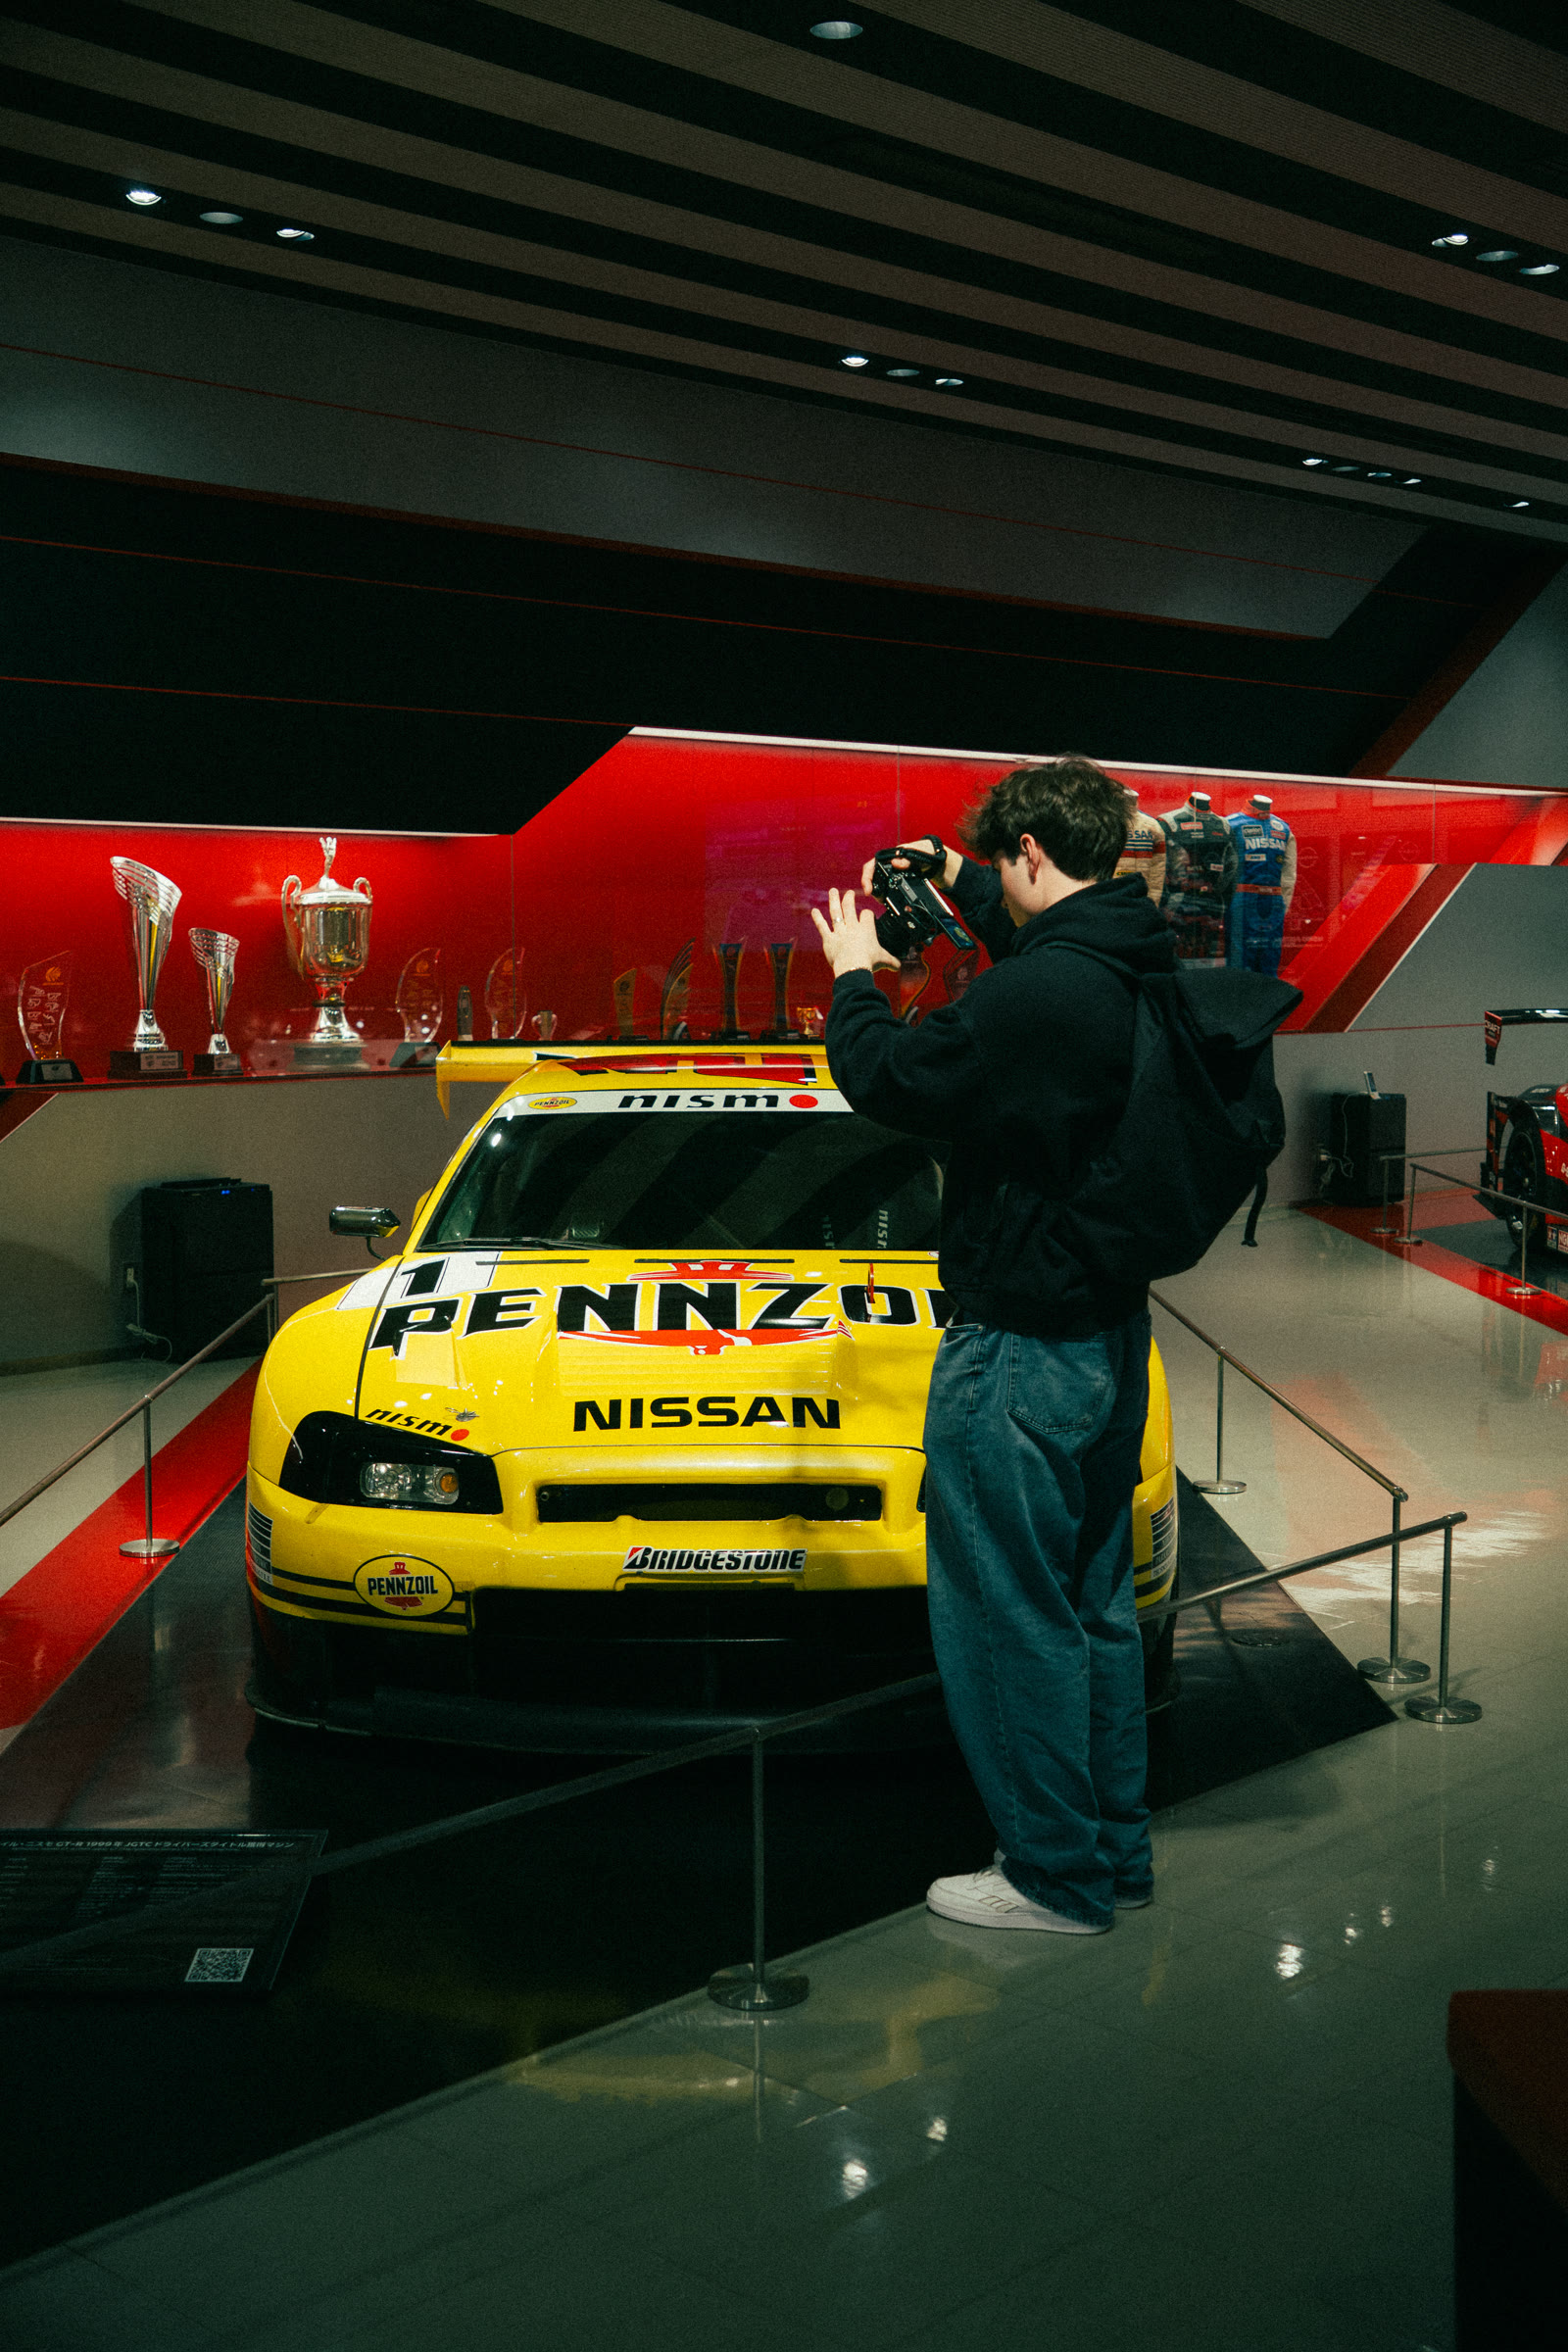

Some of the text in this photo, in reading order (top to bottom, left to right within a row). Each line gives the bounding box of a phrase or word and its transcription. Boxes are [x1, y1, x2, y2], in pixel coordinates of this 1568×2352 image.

[533, 1099, 570, 1107] PENNZOIL
[617, 1095, 779, 1109] nism
[401, 1258, 449, 1297] 1
[366, 1408, 453, 1436] nism
[572, 1396, 841, 1433] NISSAN
[624, 1545, 807, 1572] BRIDGESTONE
[367, 1574, 438, 1597] PENNZOIL
